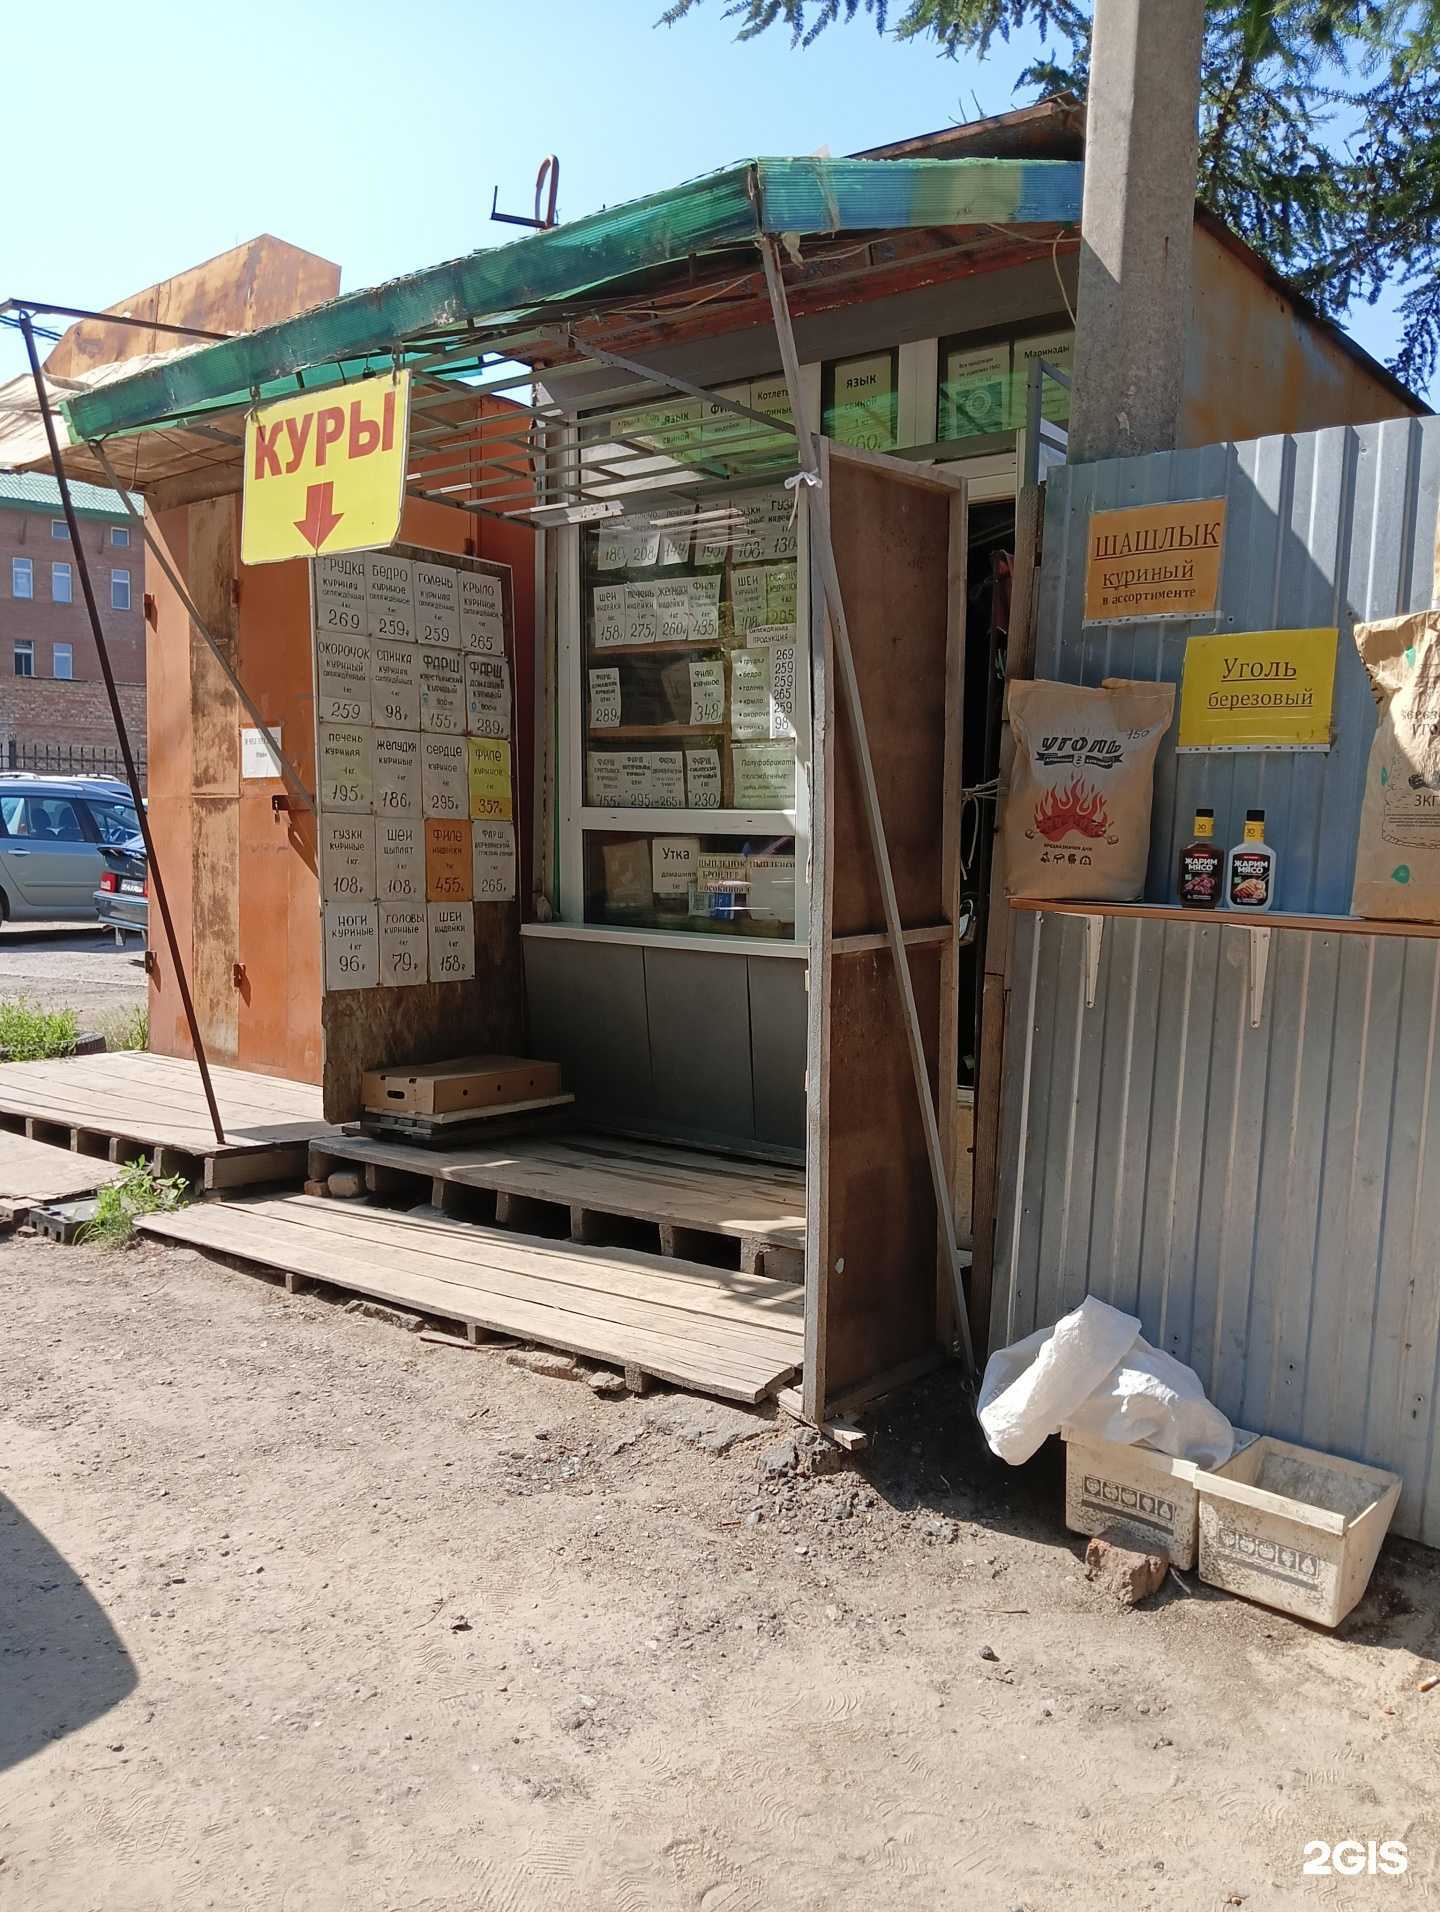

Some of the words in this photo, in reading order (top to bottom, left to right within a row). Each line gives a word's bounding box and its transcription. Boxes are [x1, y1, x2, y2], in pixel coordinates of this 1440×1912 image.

[846, 374, 877, 389] ЯЗЫК
[254, 391, 396, 480] КУРЫ
[1094, 521, 1221, 558] ШАШЛЫК
[1102, 560, 1194, 588] куриный
[462, 581, 495, 597] КРЫЛО
[1101, 593, 1109, 606] в
[1111, 585, 1196, 605] ассортименте
[470, 633, 493, 650] 265
[318, 641, 370, 661] ОКОРОЧОК
[376, 648, 412, 665] СПИНКА
[776, 648, 794, 661] 269
[423, 654, 460, 673] ФАРШ
[469, 661, 502, 679] ФАРШ
[775, 661, 794, 674] 259
[1221, 657, 1297, 679] Уголь
[774, 674, 793, 688] 259
[773, 688, 791, 700] 265
[1208, 688, 1313, 711] березовый
[331, 701, 361, 719] 259
[328, 732, 363, 743] ПЕЧЕНЬ
[377, 739, 417, 753] ЖЕЛУДКИ
[426, 744, 462, 757] СЕРДЦЕ
[1041, 736, 1122, 754] УГОЛЬ
[333, 829, 362, 840] ГУЗКИ
[387, 828, 413, 841] ШЕИ
[432, 829, 464, 842] ФИЛЕ
[662, 847, 690, 861] Утка
[1184, 858, 1218, 866] ЖАРИМ
[1187, 864, 1214, 872] МЯСО
[1233, 860, 1268, 868] ЖАРИМ
[1237, 866, 1264, 874] МЯСО
[338, 914, 368, 927] НОГИ
[386, 913, 425, 924] ГОЛОВЫ
[439, 911, 462, 923] ШЕИ
[332, 927, 375, 938] КУРИНЫЕ
